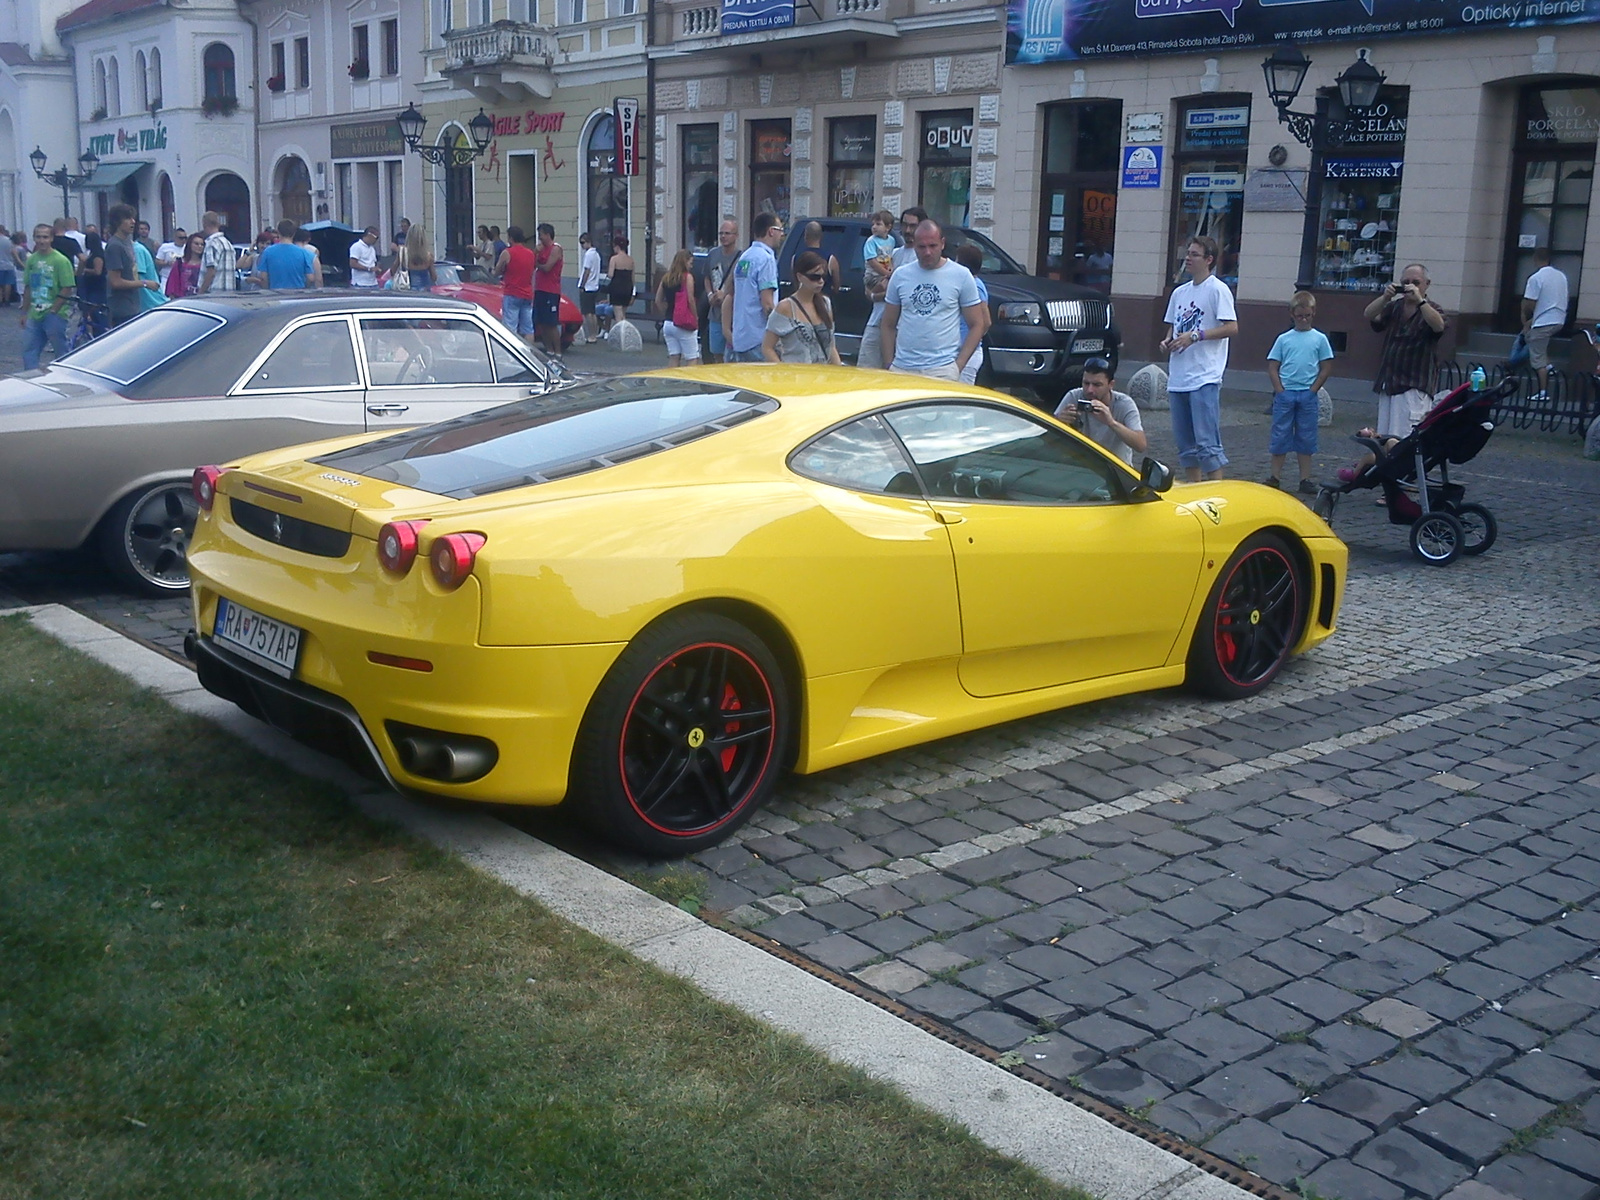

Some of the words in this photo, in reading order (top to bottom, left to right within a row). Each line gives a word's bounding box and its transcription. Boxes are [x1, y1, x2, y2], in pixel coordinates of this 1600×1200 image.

[1462, 3, 1521, 24] Optický
[1525, 0, 1585, 17] internet
[749, 18, 768, 27] TEXTILU
[768, 17, 773, 25] A
[773, 15, 790, 24] OBUVI
[1419, 20, 1428, 29] 18
[1429, 18, 1444, 28] 001
[1025, 41, 1038, 53] RS
[1040, 40, 1061, 53] NET
[1179, 37, 1202, 47] Sobota
[523, 110, 566, 134] SPORT
[623, 107, 632, 175] SPORT
[927, 128, 973, 147] OBUV
[1366, 132, 1405, 142] POTREBY
[249, 614, 298, 662] 757AP
